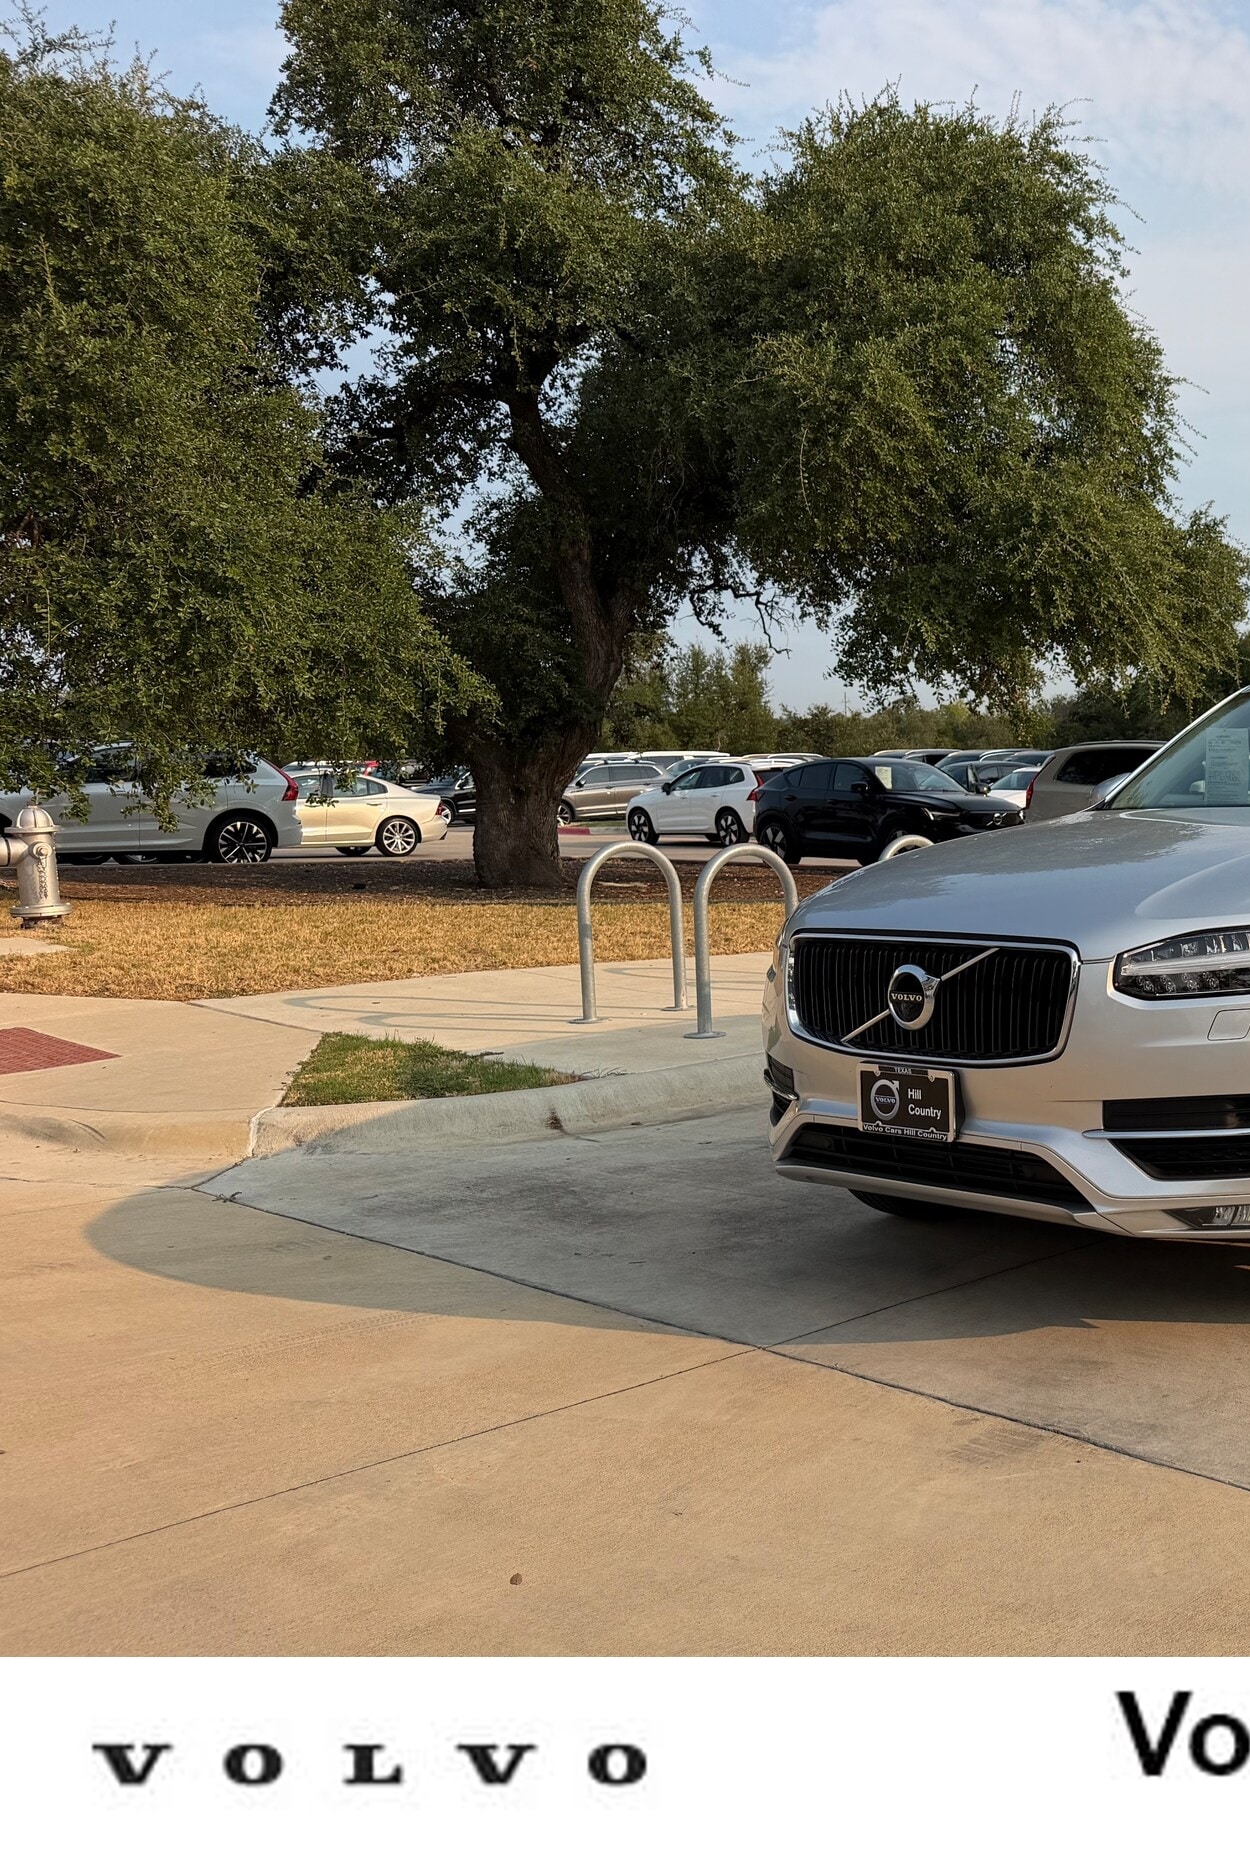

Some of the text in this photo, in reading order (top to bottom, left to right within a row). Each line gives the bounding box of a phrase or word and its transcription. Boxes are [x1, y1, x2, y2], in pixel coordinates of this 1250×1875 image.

[891, 993, 922, 1002] VOLVO
[894, 1067, 912, 1075] TEXAS
[907, 1088, 922, 1100] Hill
[908, 1104, 942, 1120] Country
[863, 1124, 948, 1141] Volvo Cars Hill Country
